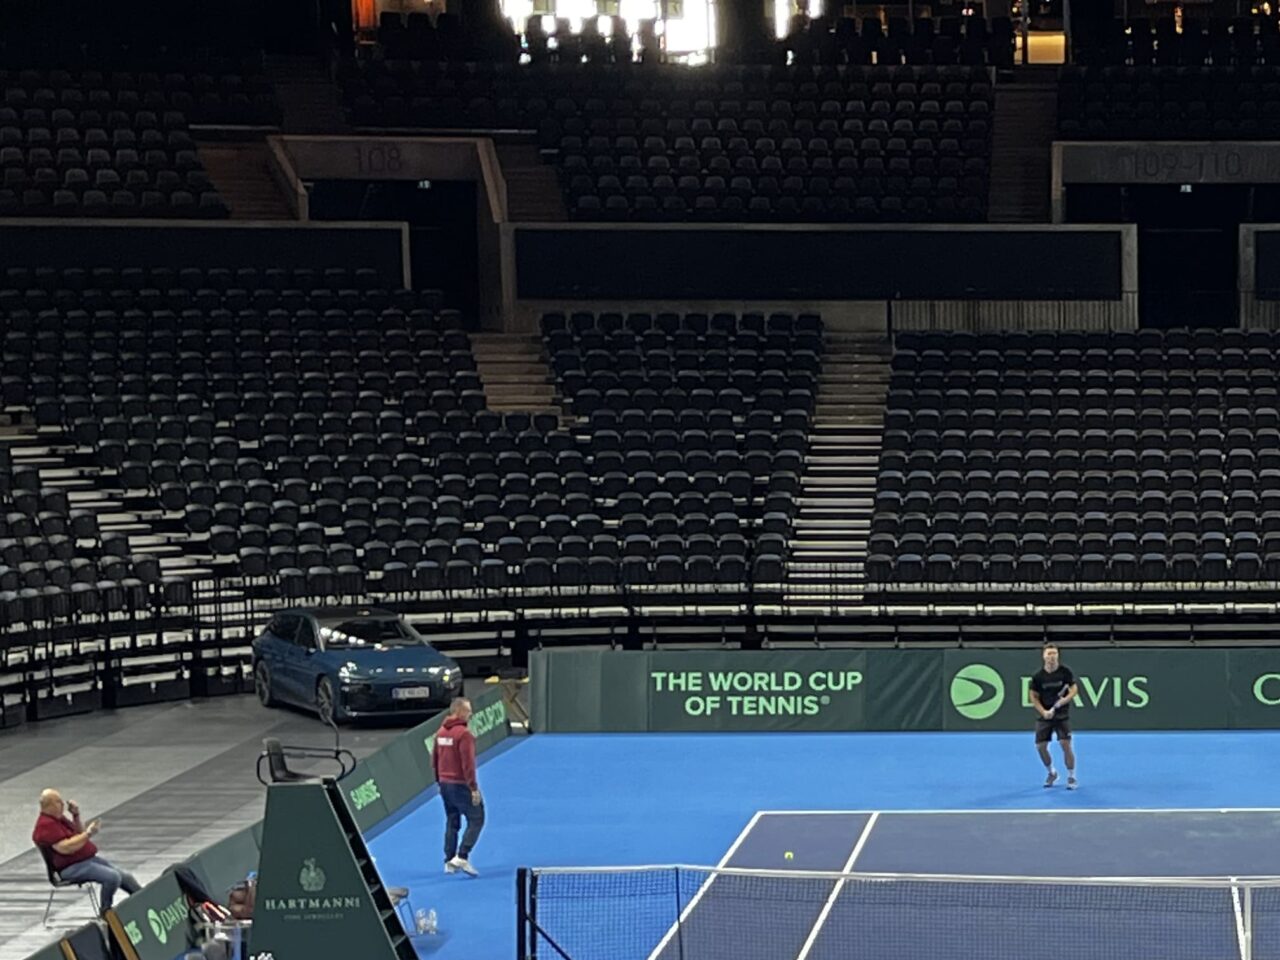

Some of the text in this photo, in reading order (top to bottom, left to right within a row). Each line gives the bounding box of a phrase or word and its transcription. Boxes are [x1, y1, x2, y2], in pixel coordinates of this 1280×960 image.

[354, 146, 402, 172] 108
[651, 671, 863, 691] THE WORLD CUP
[1020, 676, 1150, 708] VIS
[685, 696, 720, 715] OF
